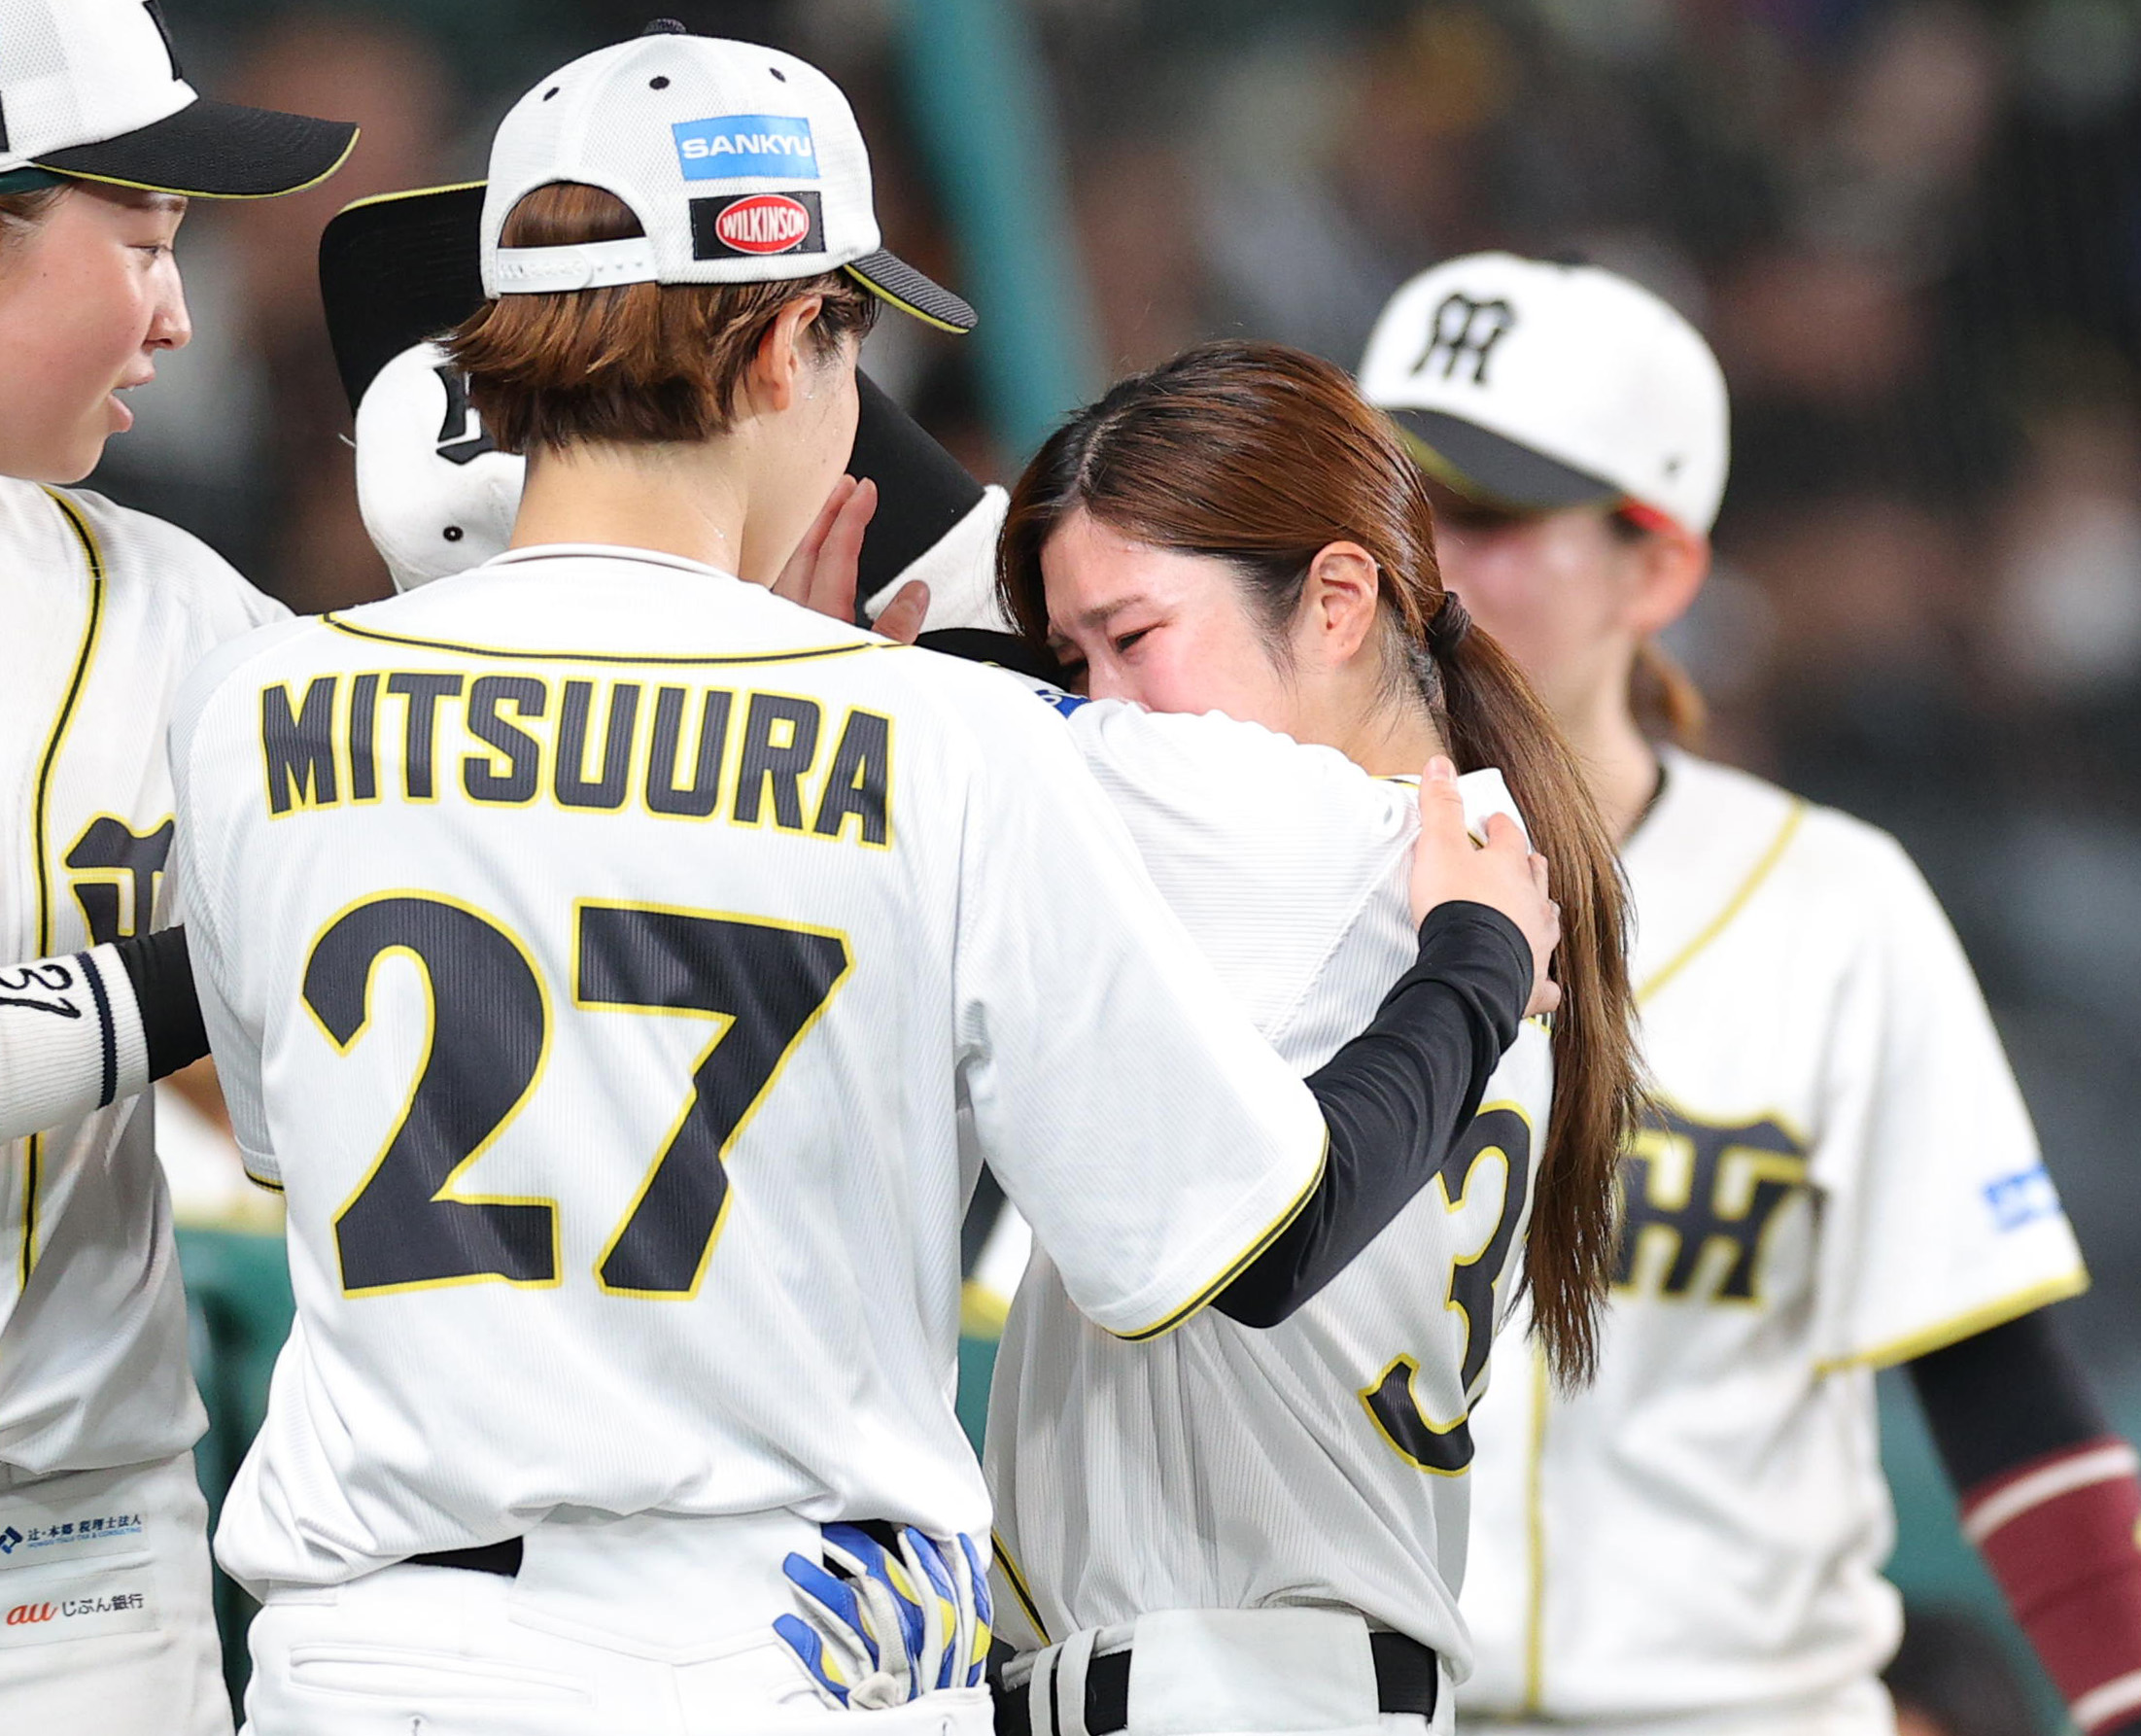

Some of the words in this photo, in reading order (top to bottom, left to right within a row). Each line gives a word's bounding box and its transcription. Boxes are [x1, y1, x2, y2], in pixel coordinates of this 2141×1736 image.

[682, 133, 812, 159] SANKYU
[722, 206, 806, 243] WILKINSON
[259, 670, 893, 851] MITSUURA
[300, 888, 855, 1301] 27
[62, 1593, 144, 1617] じぶん銀行
